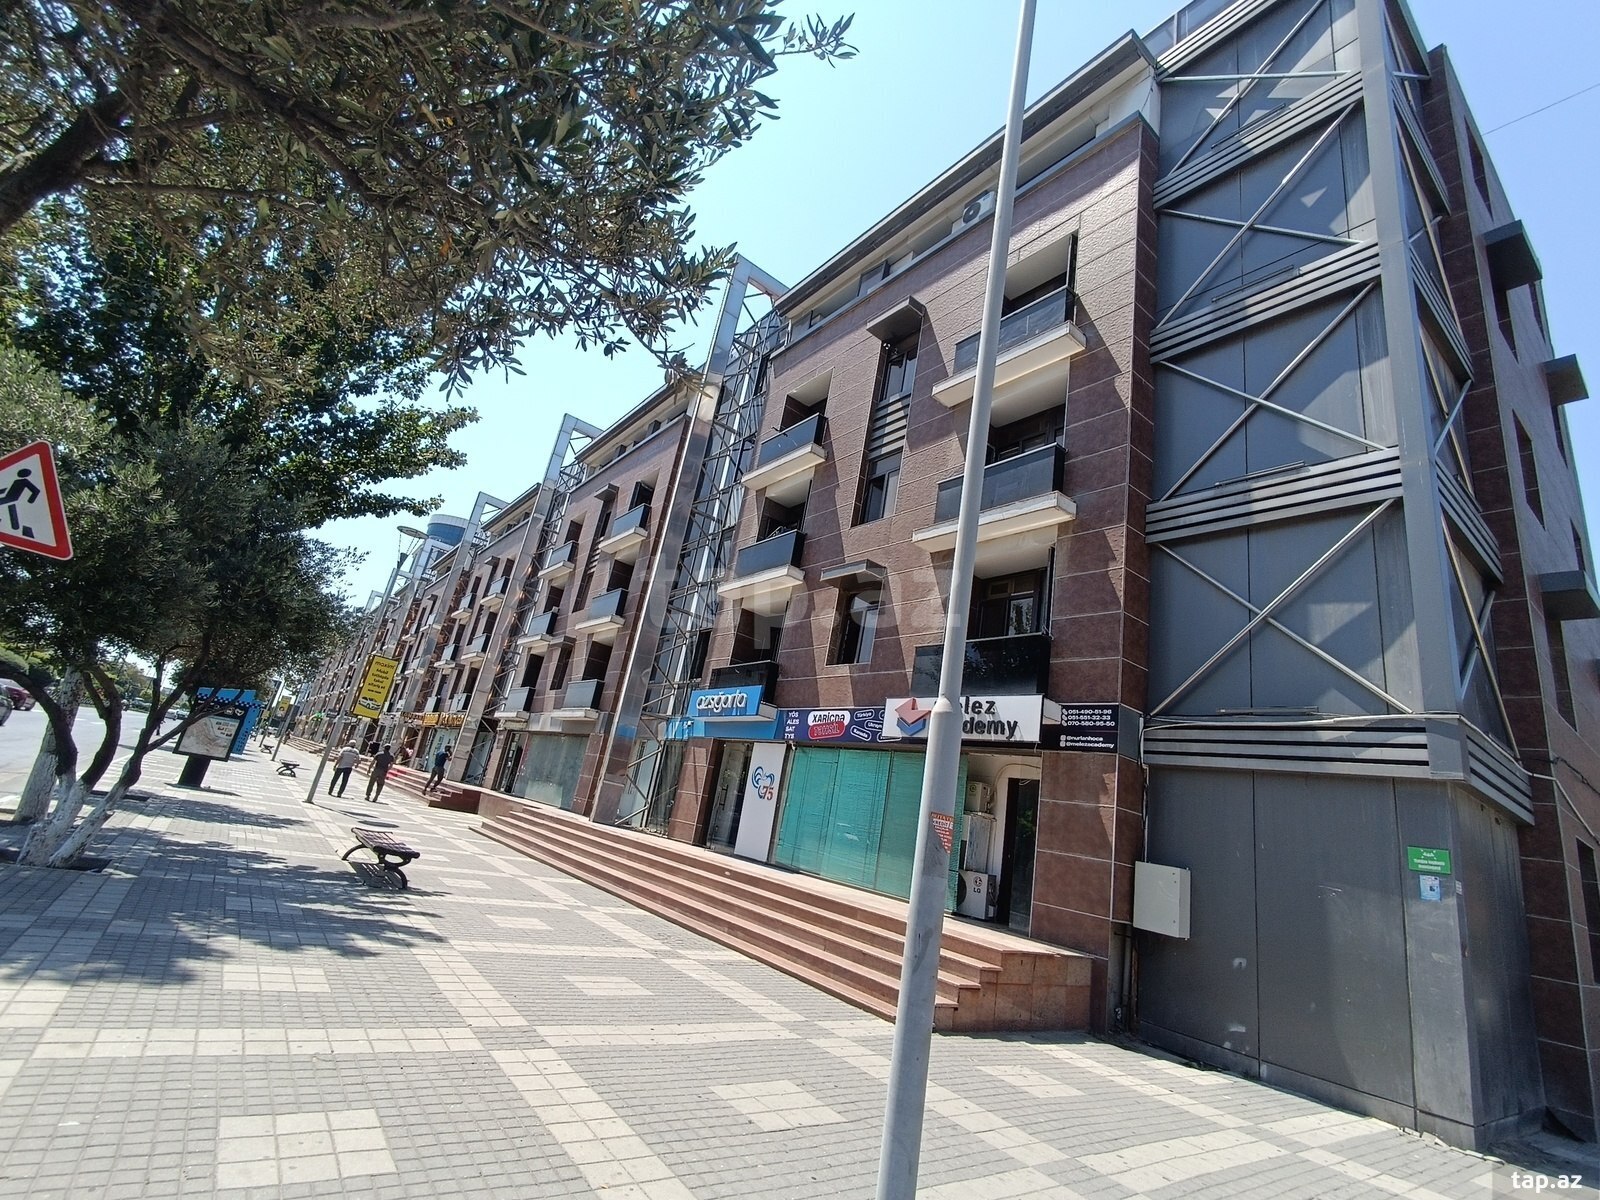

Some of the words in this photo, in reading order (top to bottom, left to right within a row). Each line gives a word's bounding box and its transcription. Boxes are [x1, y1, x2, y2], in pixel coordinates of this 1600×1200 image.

[960, 696, 996, 715] lez
[962, 717, 1018, 740] demy
[762, 785, 774, 800] 75
